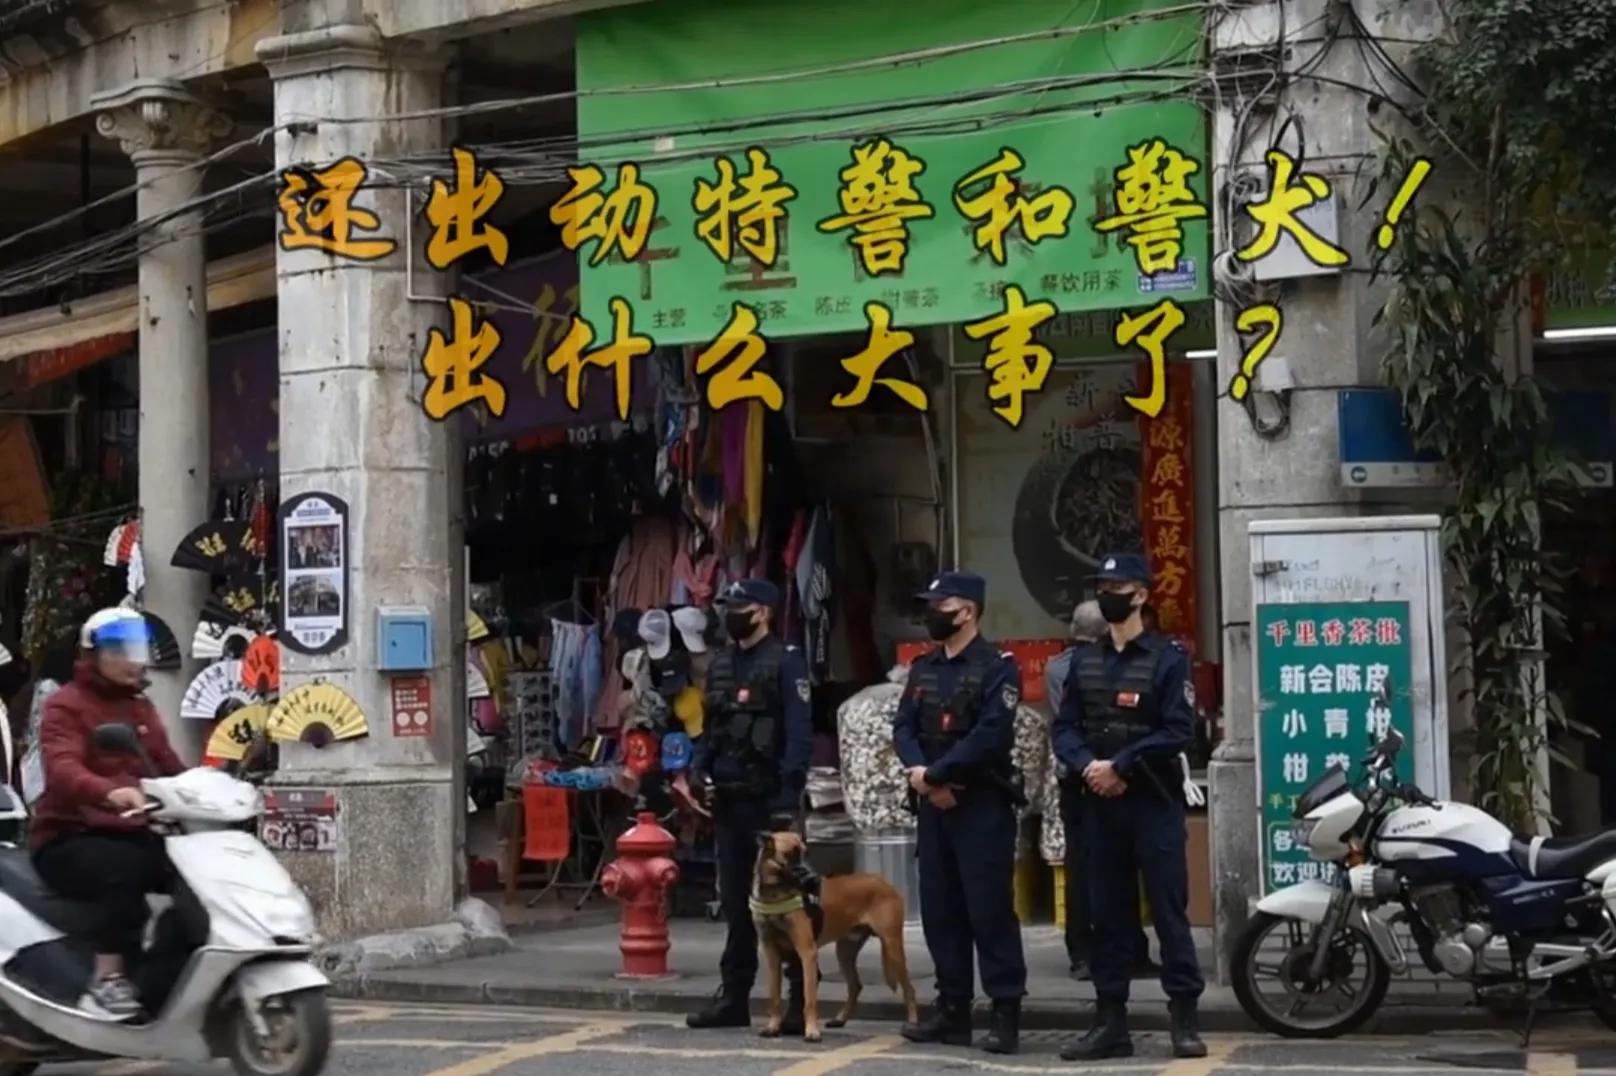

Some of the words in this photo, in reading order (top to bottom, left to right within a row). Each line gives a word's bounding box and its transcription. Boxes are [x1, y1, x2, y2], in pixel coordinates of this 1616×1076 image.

[1266, 617, 1402, 647] 千里香茶批
[1280, 663, 1390, 693] 新会陈皮
